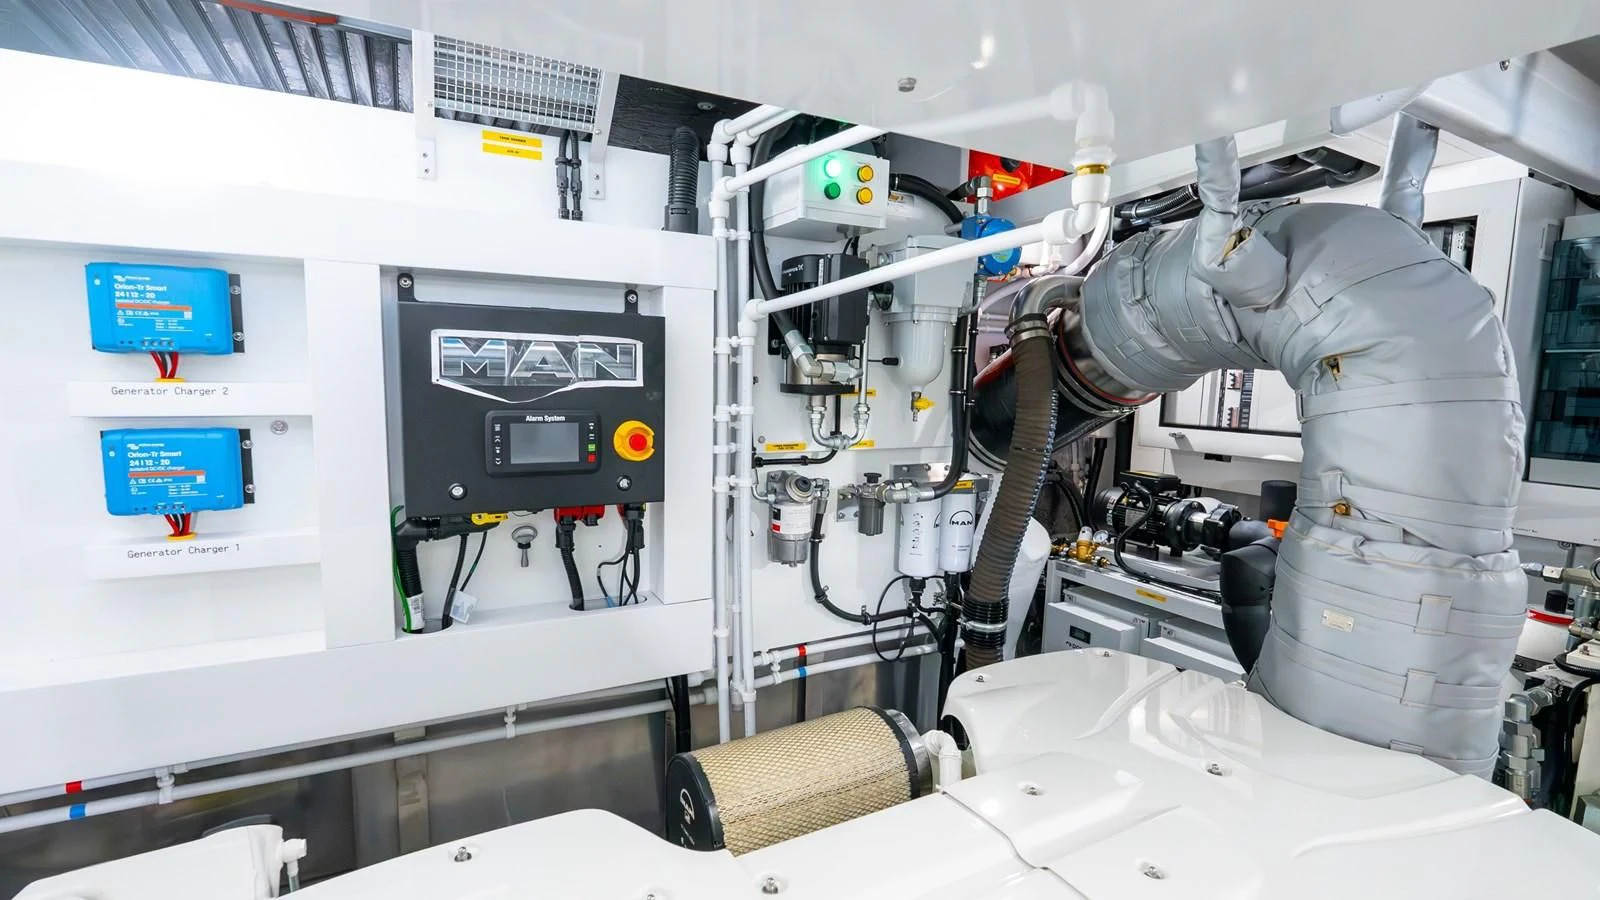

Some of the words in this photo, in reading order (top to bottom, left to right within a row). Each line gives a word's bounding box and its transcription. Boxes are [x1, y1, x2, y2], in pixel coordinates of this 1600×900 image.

[114, 283, 144, 291] Orion-Tr
[440, 337, 636, 379] MAN
[111, 386, 169, 396] Generator
[175, 386, 216, 397] Charger
[222, 386, 230, 396] 2
[544, 415, 566, 423] System
[127, 548, 183, 559] Generator
[188, 545, 230, 554] Charger
[235, 543, 240, 551] 1
